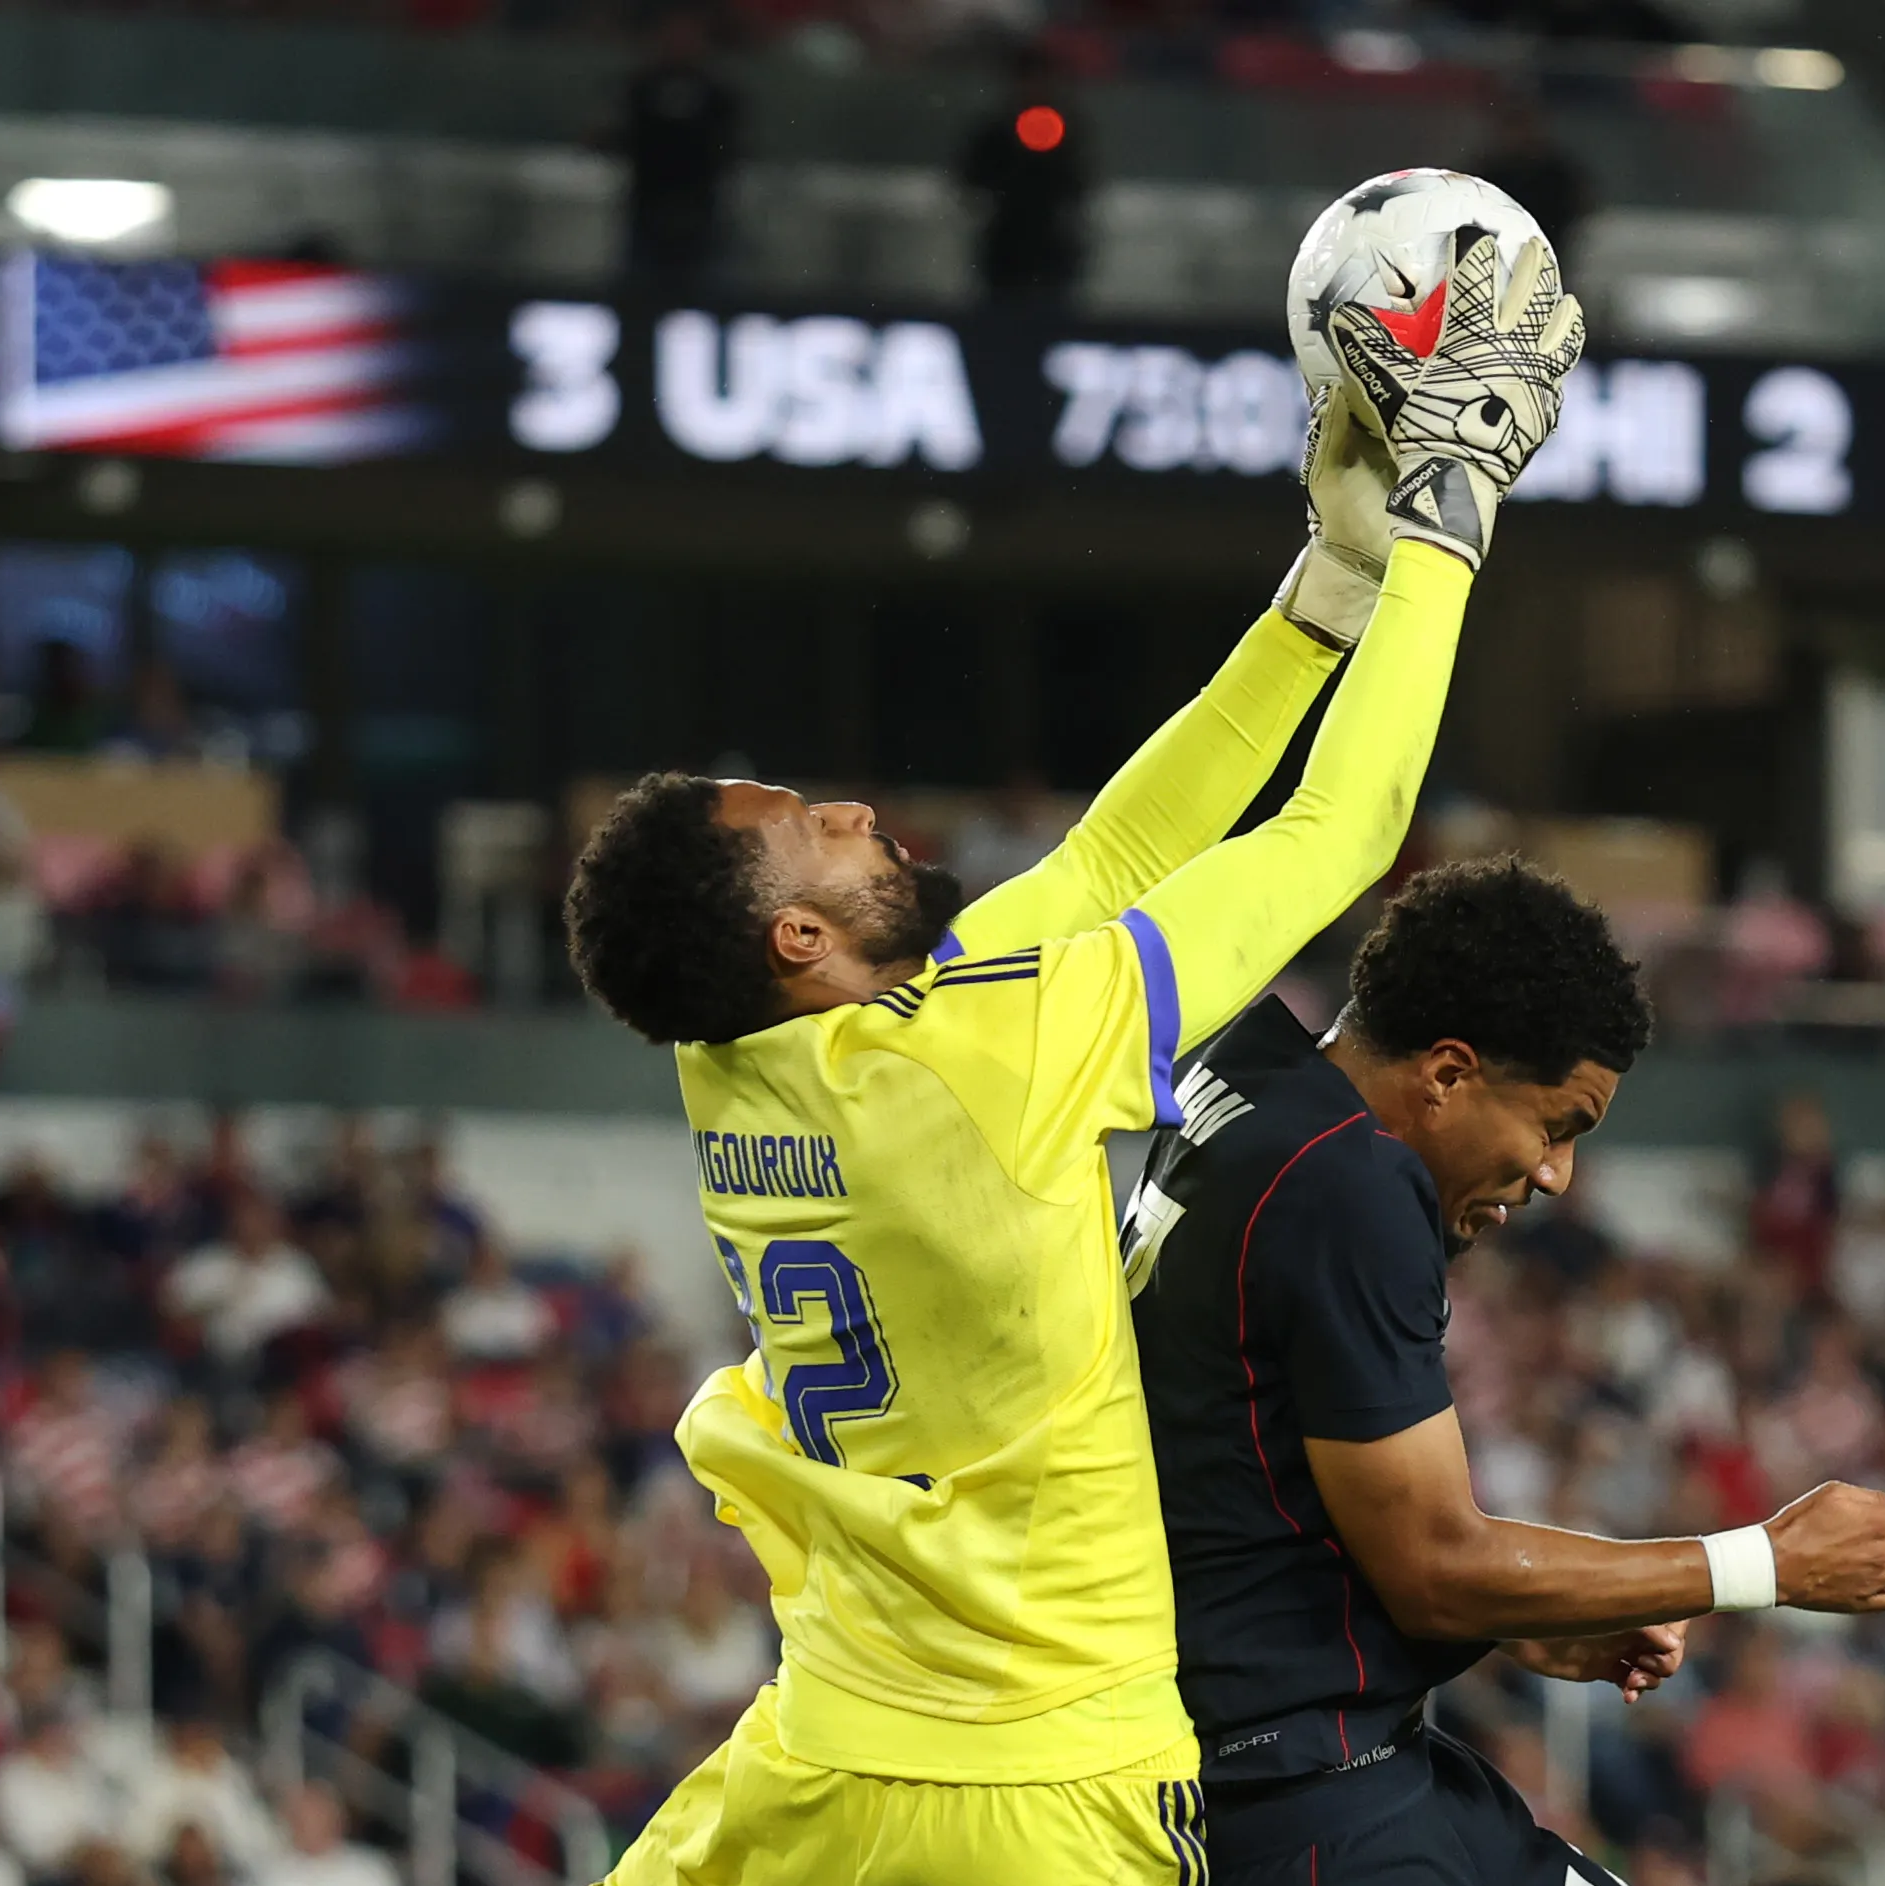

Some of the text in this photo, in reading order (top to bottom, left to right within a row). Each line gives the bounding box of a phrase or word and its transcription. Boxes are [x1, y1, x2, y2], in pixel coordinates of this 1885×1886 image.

[1344, 341, 1393, 404] uhlsport
[509, 299, 621, 454] 3
[653, 308, 984, 474] USA
[1741, 364, 1854, 515] 2
[1389, 462, 1442, 507] uhlsport
[691, 1128, 849, 1198] IGOUROUX
[1371, 1741, 1397, 1763] Klein
